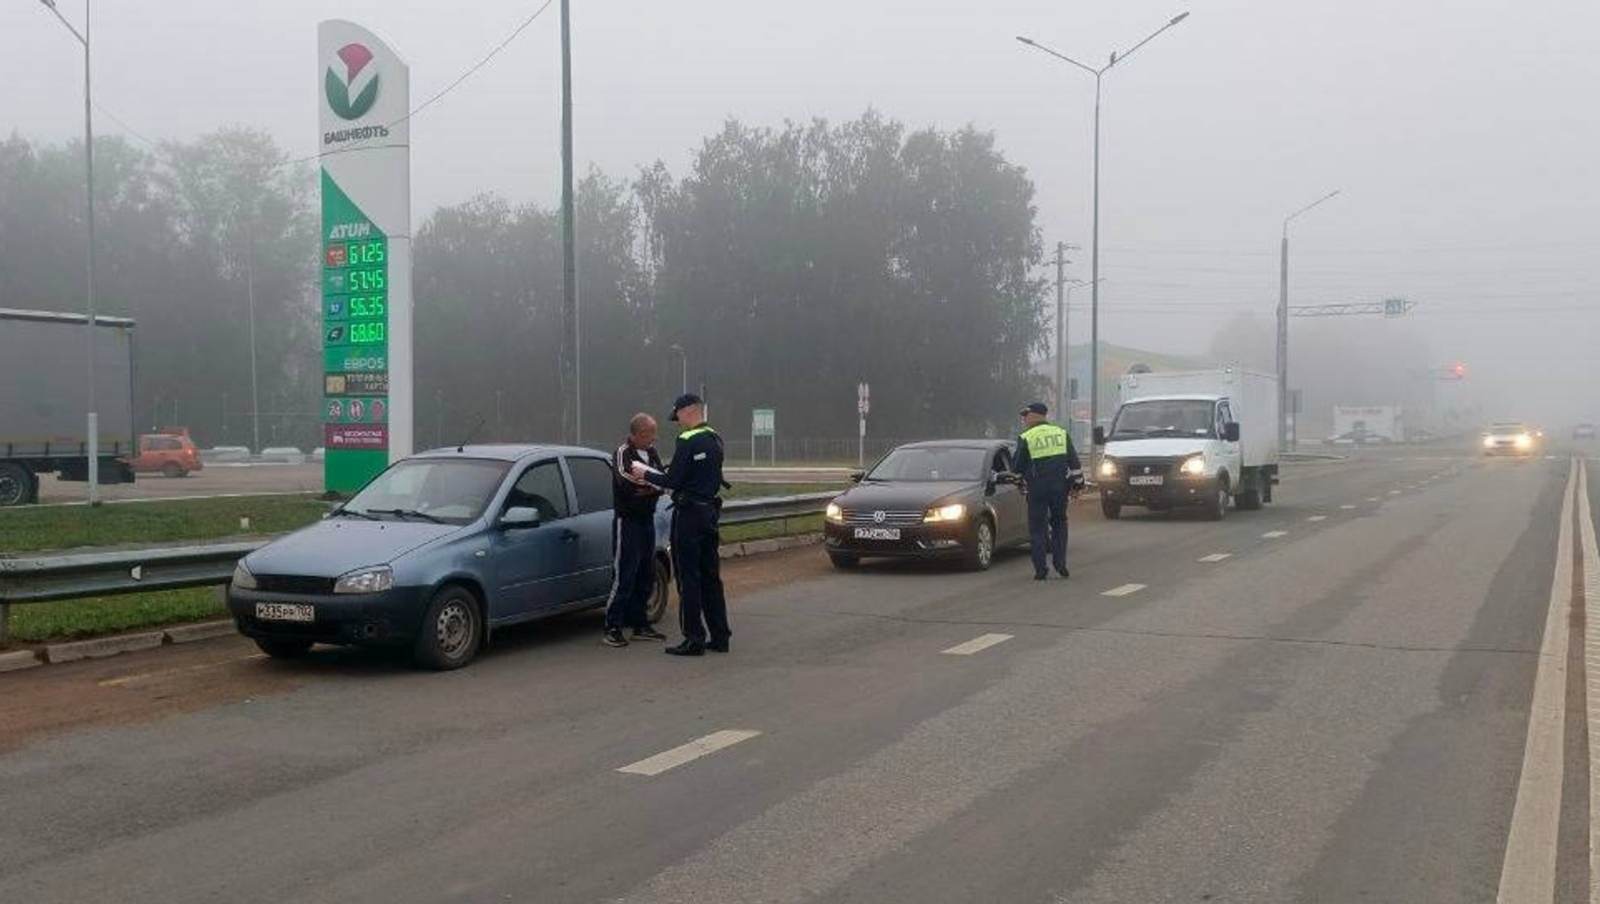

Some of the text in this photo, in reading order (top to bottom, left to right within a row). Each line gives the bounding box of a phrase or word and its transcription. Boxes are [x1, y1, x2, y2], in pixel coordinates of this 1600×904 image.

[324, 125, 389, 145] БАШНЕФТЬ
[329, 223, 371, 239] ATUM
[1034, 434, 1064, 450] ДПС
